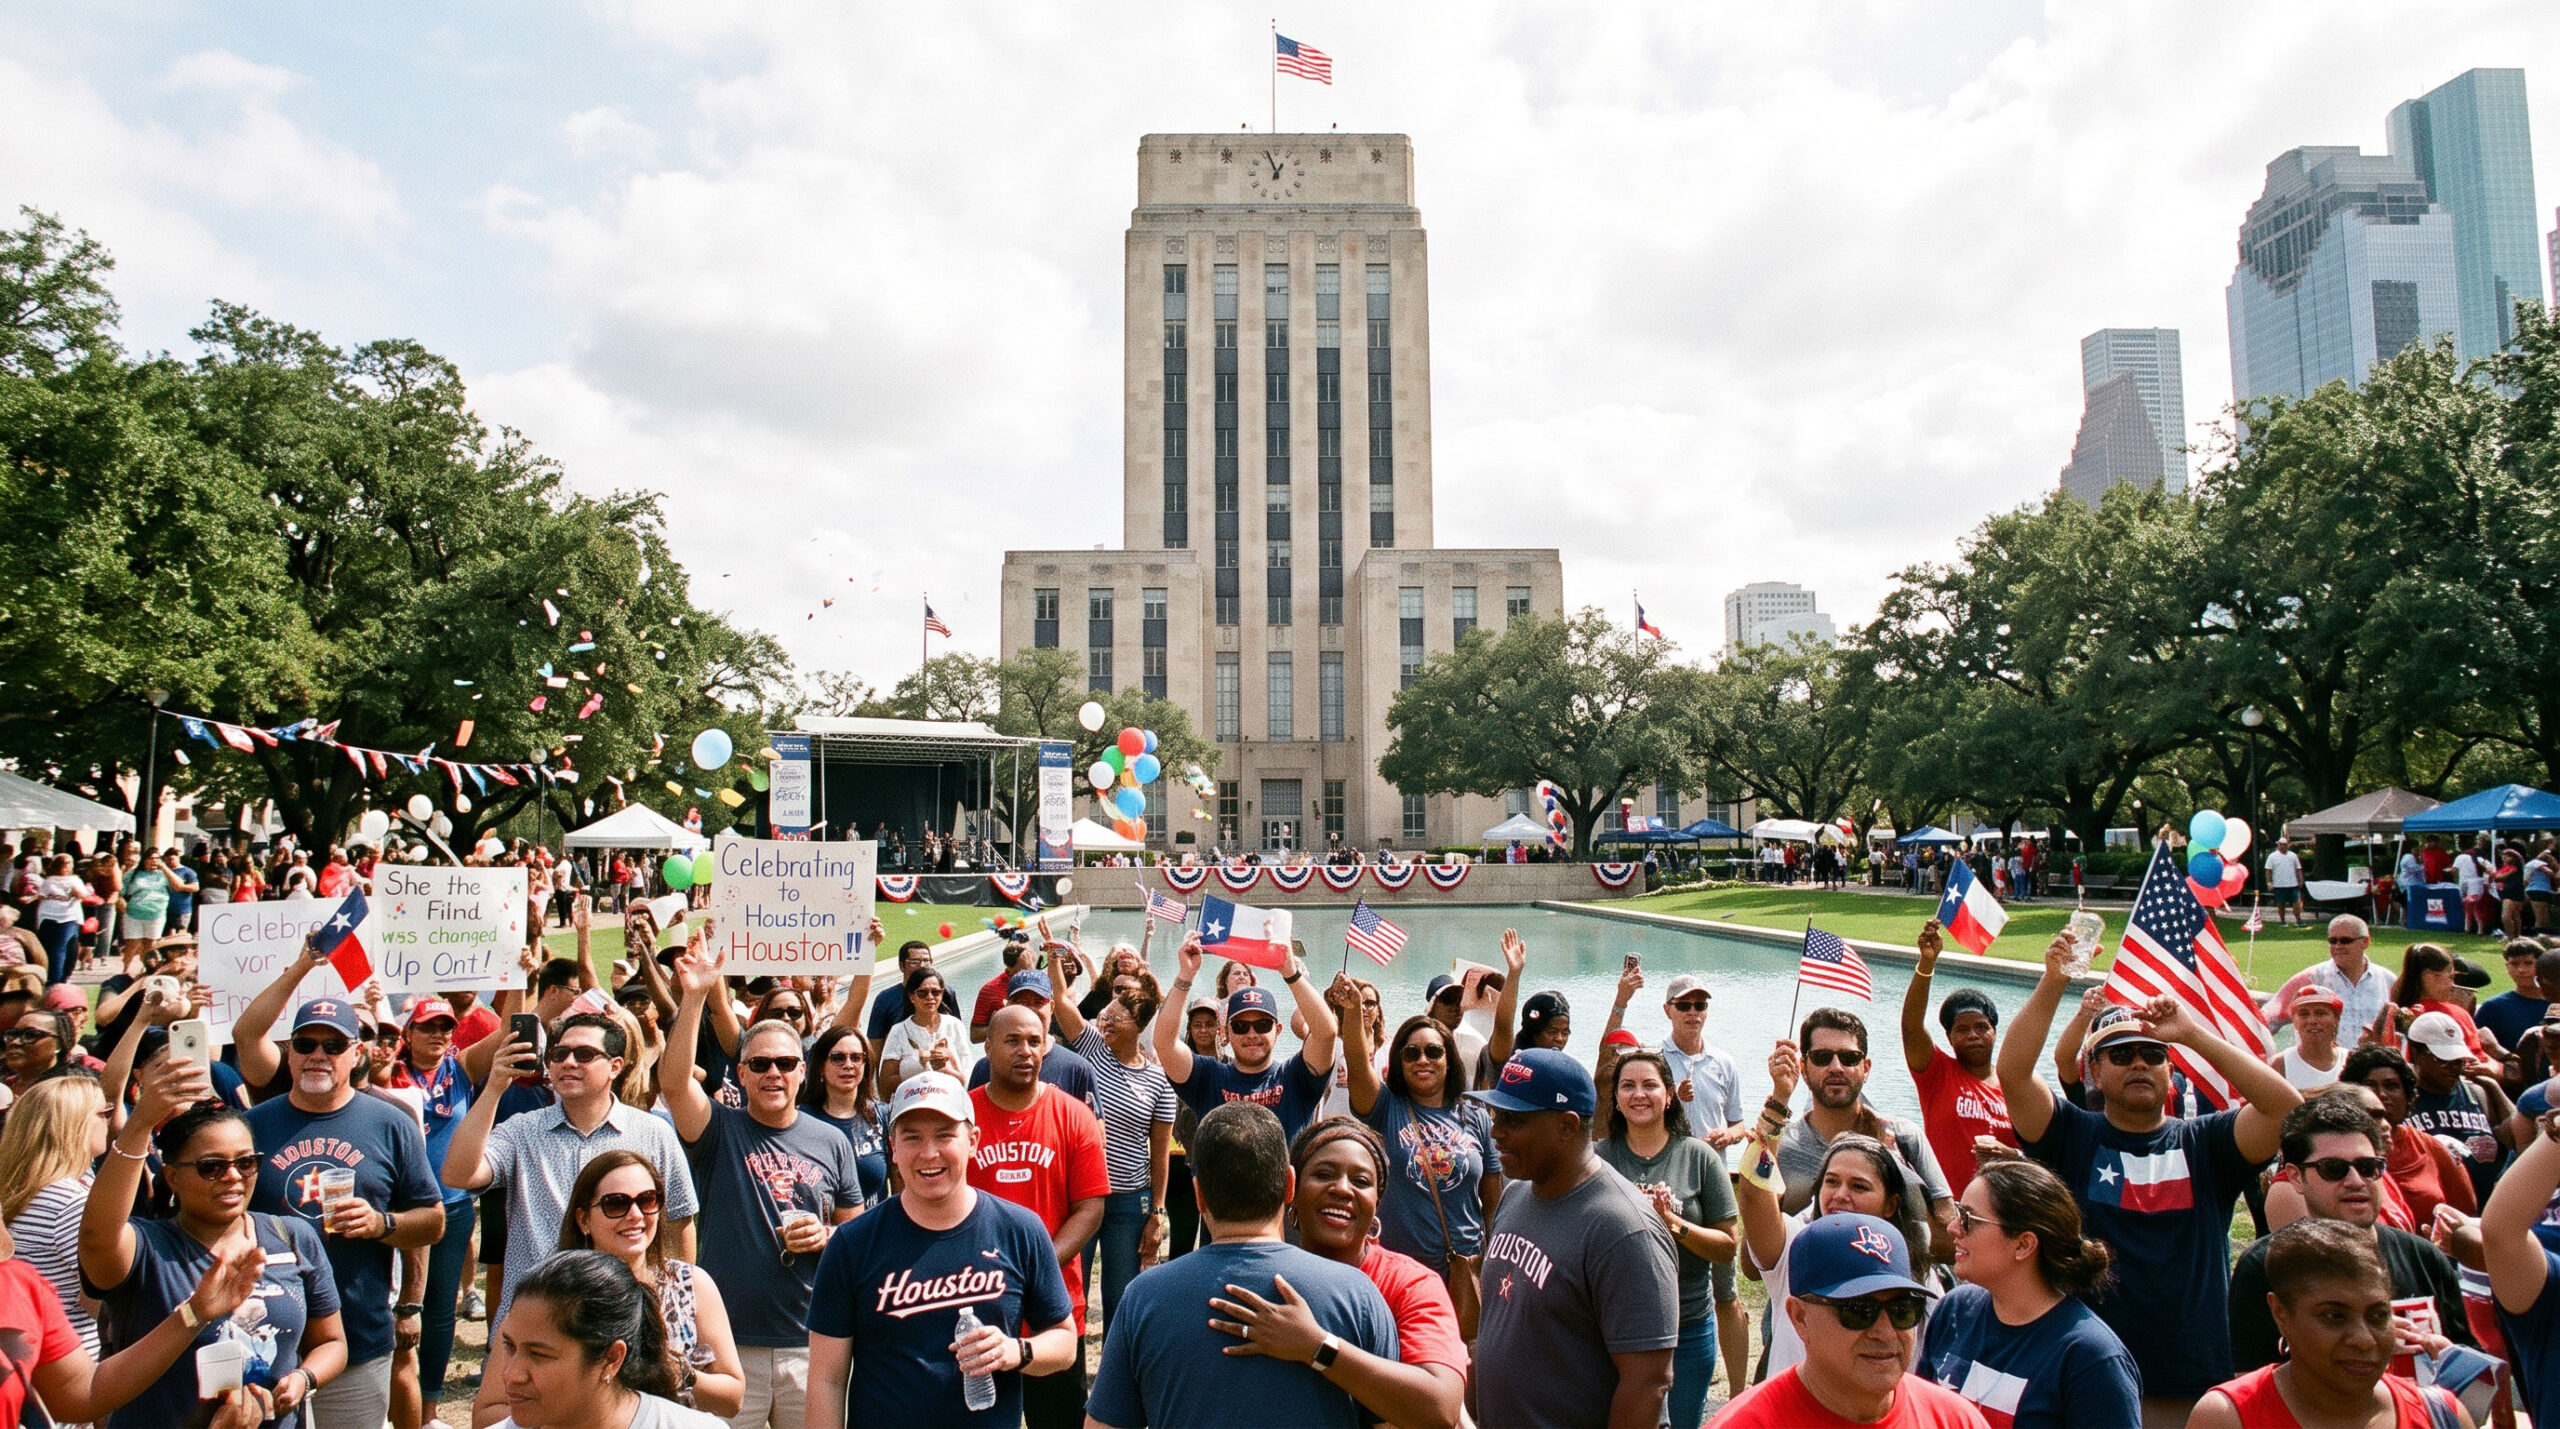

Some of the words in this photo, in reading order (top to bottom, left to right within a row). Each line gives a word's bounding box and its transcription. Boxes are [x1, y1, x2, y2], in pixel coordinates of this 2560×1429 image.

[721, 842, 855, 890] Celebrating
[385, 871, 431, 896] She
[447, 874, 481, 896] the
[778, 881, 800, 902] to
[745, 904, 835, 928] Houston
[428, 924, 498, 948] changed
[384, 950, 420, 985] Up
[974, 1141, 1056, 1170] HOUSTON
[876, 1265, 1006, 1313] Houston
